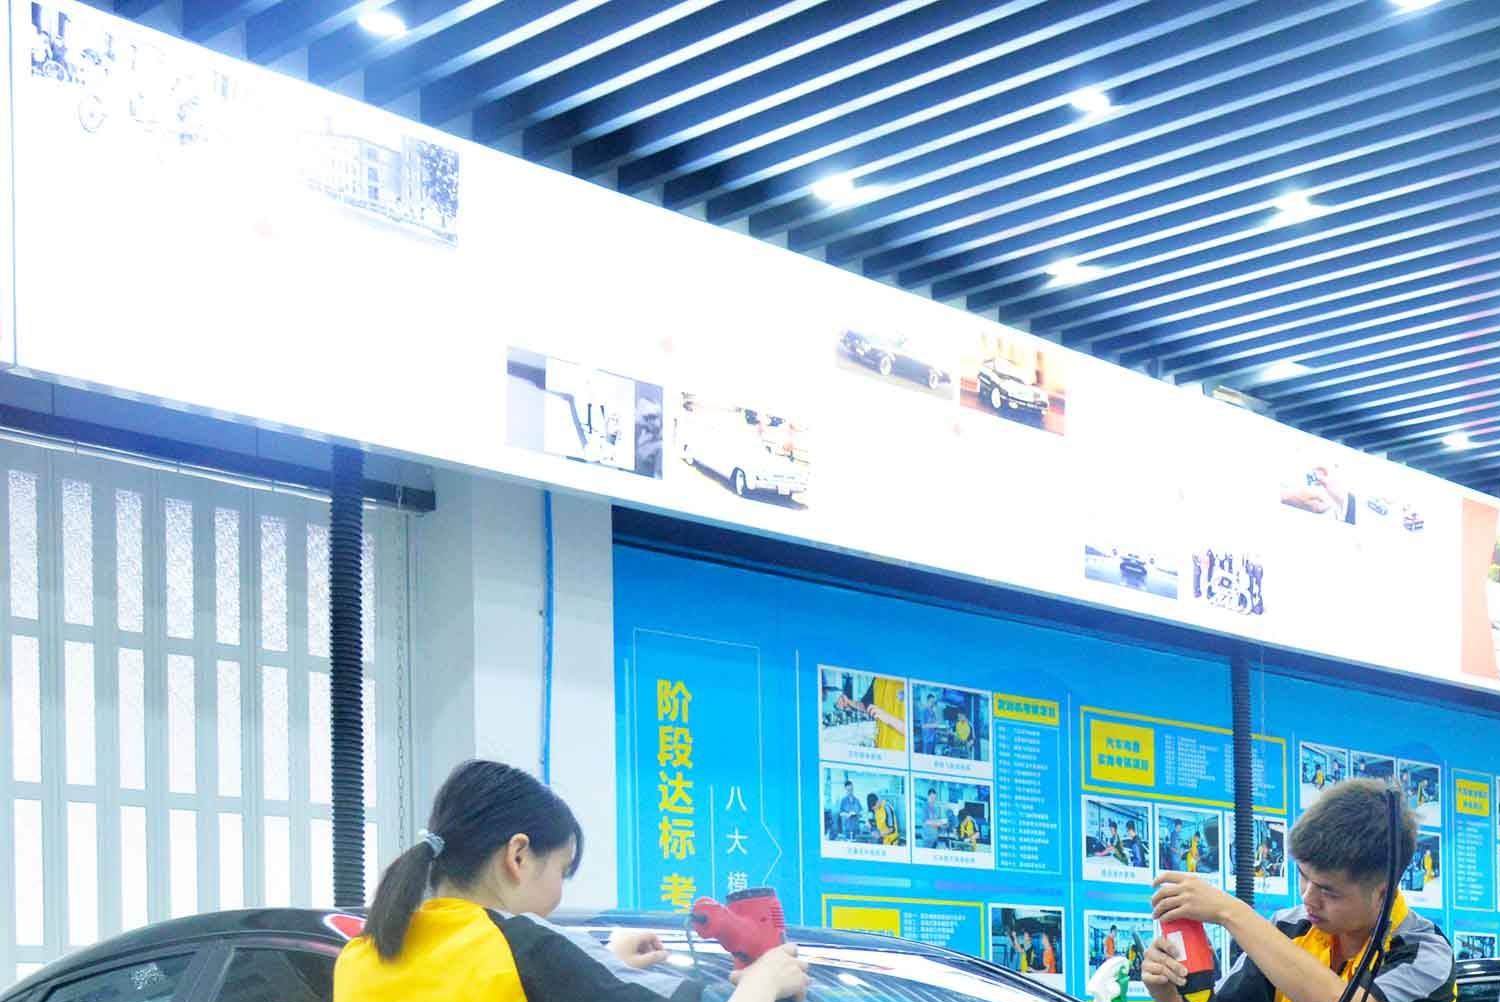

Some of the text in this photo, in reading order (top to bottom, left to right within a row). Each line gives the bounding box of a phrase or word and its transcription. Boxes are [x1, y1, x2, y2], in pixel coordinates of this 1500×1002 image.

[657, 679, 697, 914] 阶段达标考
